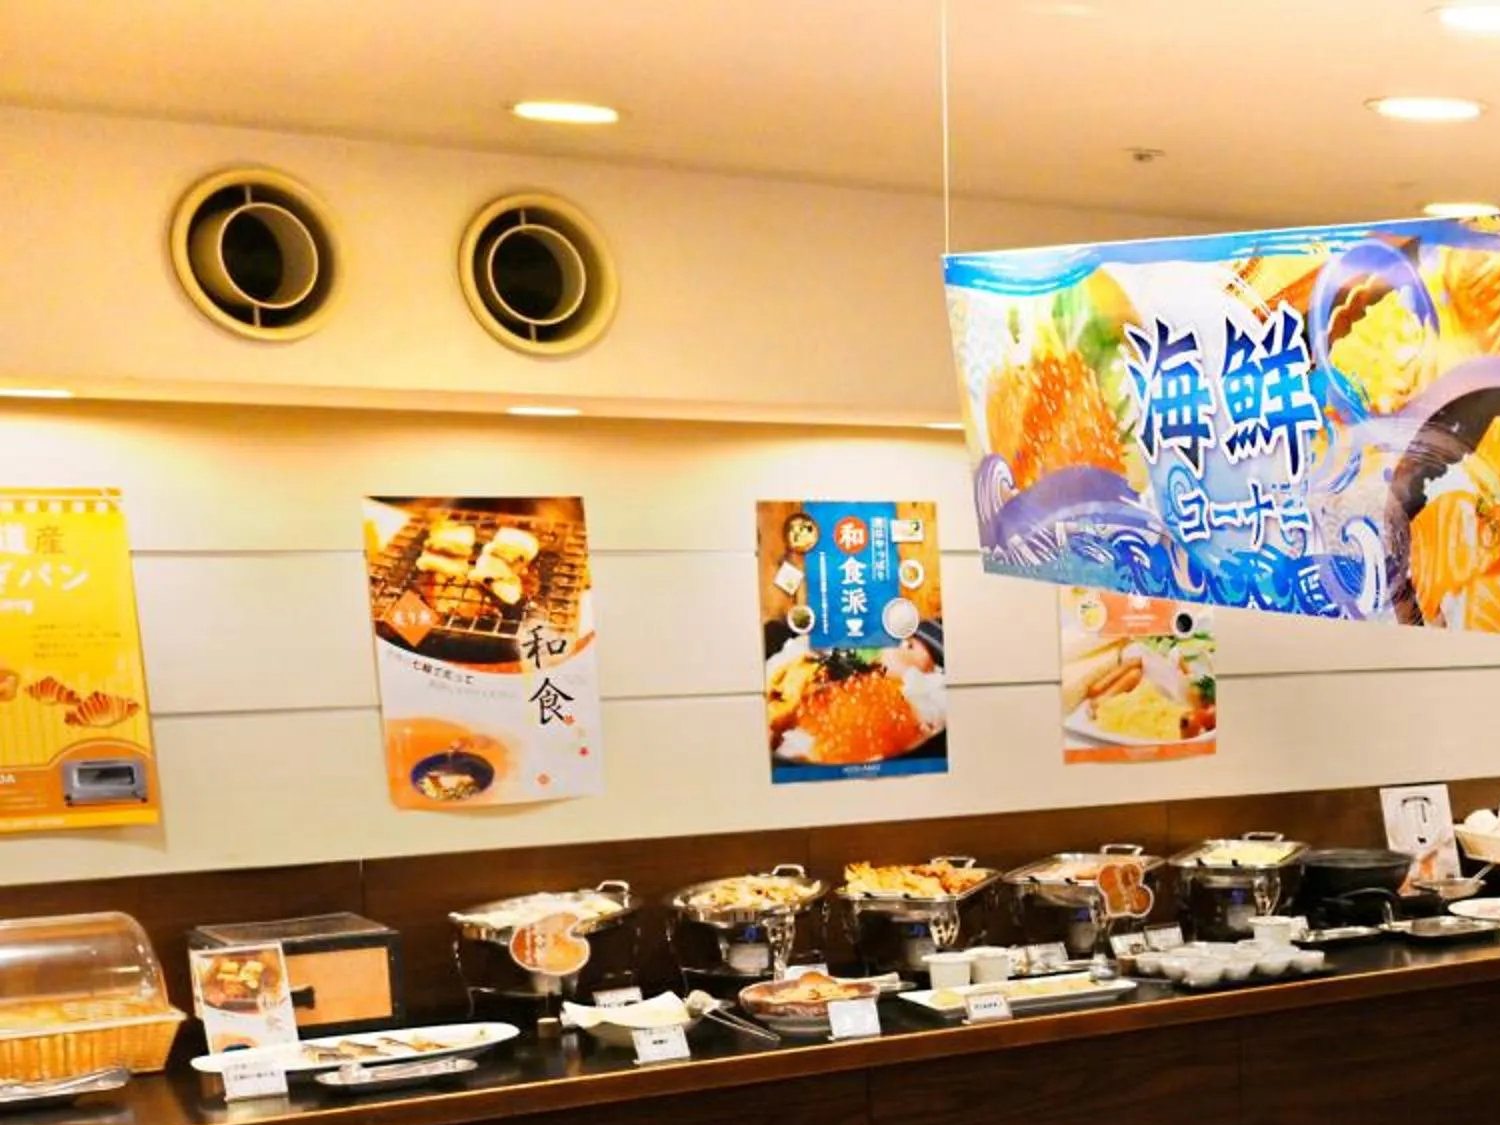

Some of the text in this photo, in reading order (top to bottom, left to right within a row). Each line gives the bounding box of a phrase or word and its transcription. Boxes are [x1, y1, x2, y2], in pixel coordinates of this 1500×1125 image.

[1123, 303, 1322, 481] 海鮮
[1177, 482, 1312, 548] コーナー
[522, 625, 575, 725] 和食
